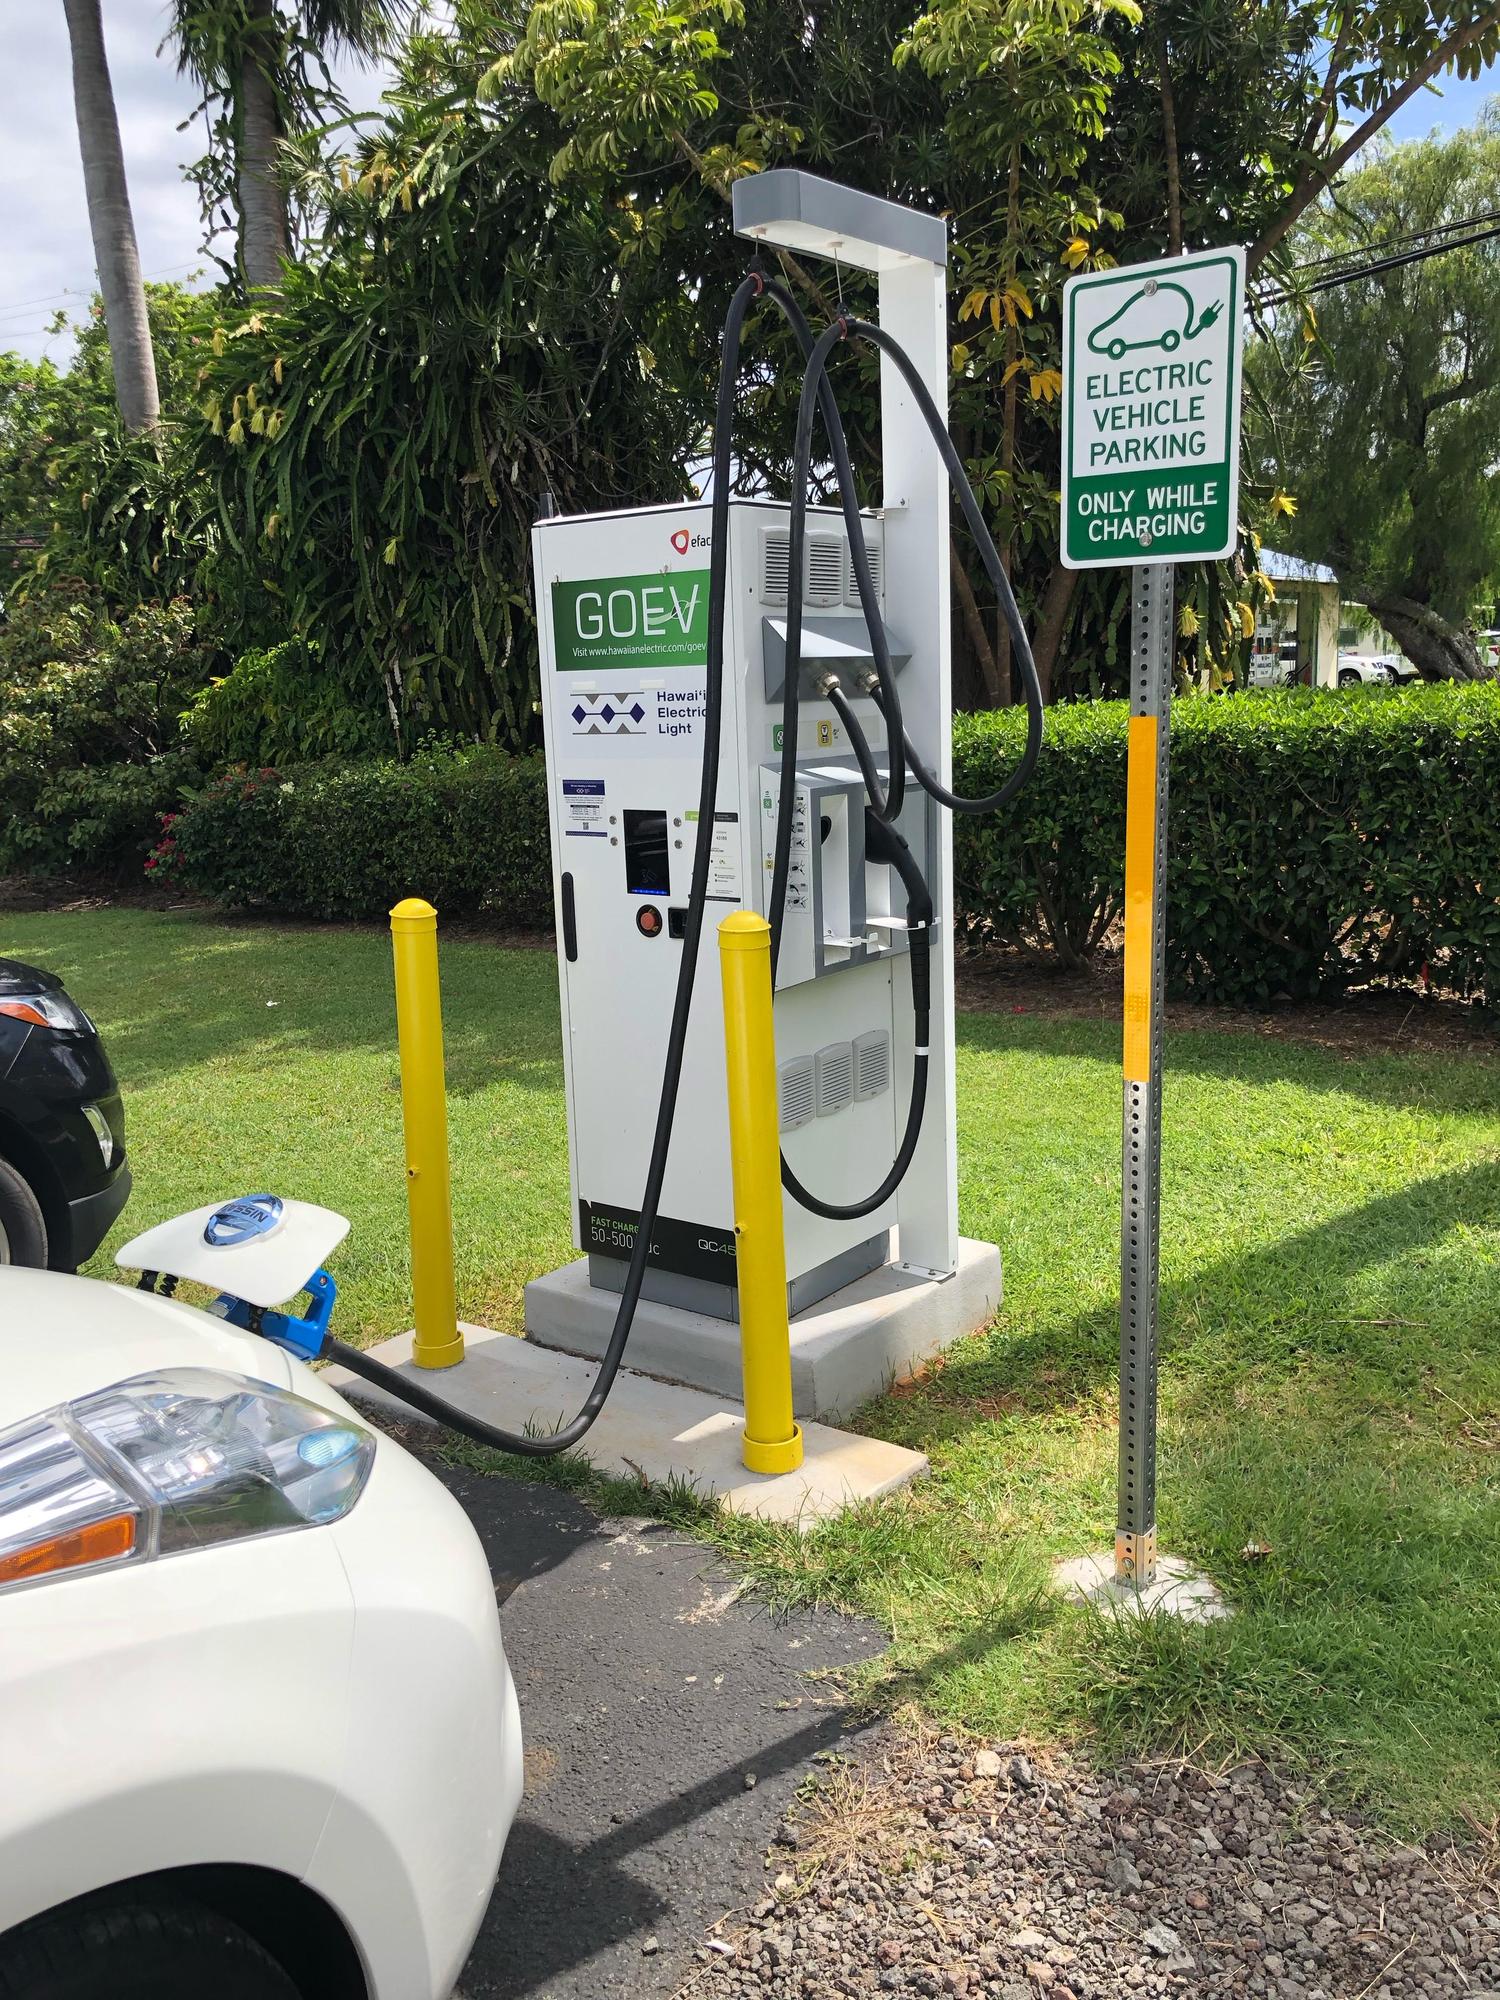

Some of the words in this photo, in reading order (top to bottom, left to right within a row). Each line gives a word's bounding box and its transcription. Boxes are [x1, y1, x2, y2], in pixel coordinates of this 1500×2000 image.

[1086, 359, 1213, 401] ELECTRIC
[1093, 395, 1205, 432] VEHICLE
[1090, 431, 1206, 467] PARKING
[1077, 489, 1135, 516] ONLY
[1146, 482, 1218, 510] WHILE
[1088, 511, 1205, 542] CHARGING
[575, 584, 699, 640] GOEV
[572, 647, 588, 657] Visit
[658, 723, 692, 736] Light
[591, 1216, 610, 1228] FAST
[591, 1226, 634, 1249] 50-500
